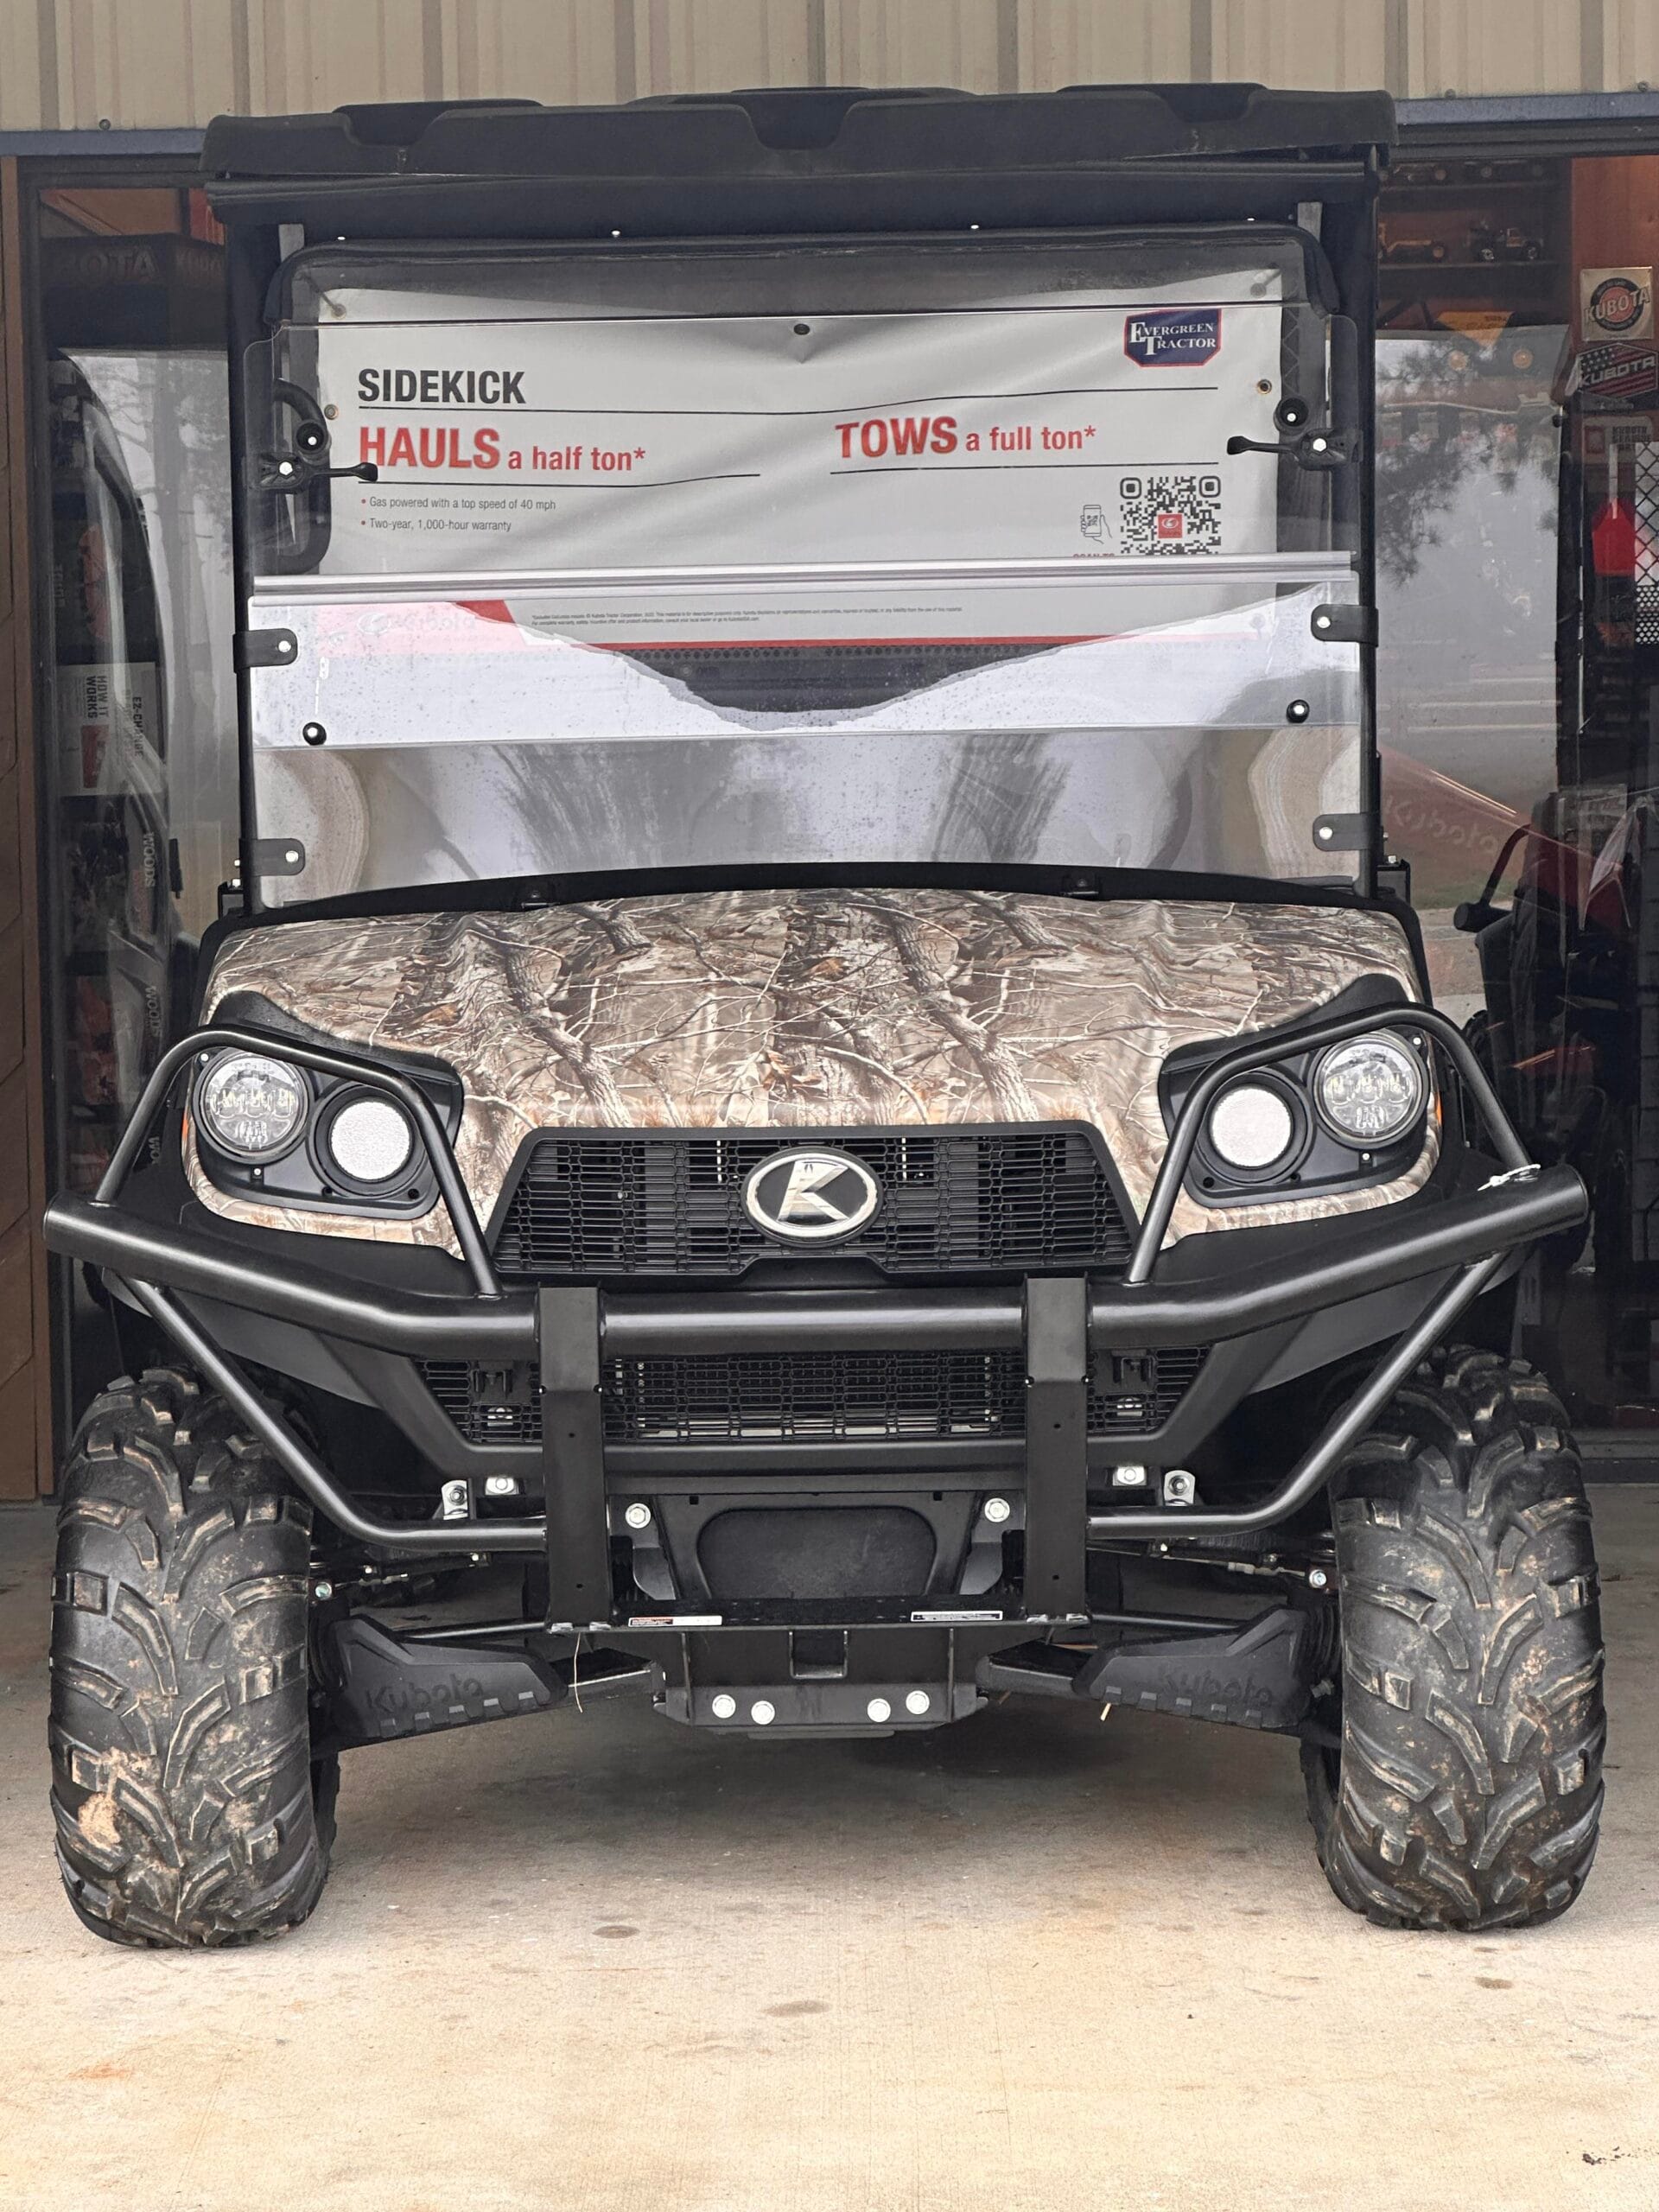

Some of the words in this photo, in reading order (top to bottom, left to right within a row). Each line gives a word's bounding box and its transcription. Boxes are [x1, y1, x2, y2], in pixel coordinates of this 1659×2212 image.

[1584, 286, 1650, 324] KUBOTA
[1129, 321, 1215, 343] EVERGREEN
[1141, 335, 1217, 356] TRACTOR
[358, 368, 526, 404] SIDEKICK
[1580, 355, 1656, 385] KUBOTA
[359, 426, 501, 469] HAULS
[507, 450, 522, 470] a
[532, 446, 582, 471] half
[835, 416, 958, 459] TOWS
[966, 432, 980, 452] a
[989, 426, 1032, 451] full
[369, 496, 387, 508] Gas
[390, 497, 429, 510] powered
[431, 498, 450, 509] with
[453, 499, 459, 509] a
[461, 499, 476, 512] top
[478, 499, 506, 512] speed
[508, 499, 518, 510] of
[520, 499, 533, 510] 40
[536, 499, 556, 512] mph
[369, 518, 415, 531] Two-year,
[418, 518, 469, 531] 1,000-hour
[472, 520, 512, 532] warranty
[86, 675, 98, 719] WORKS
[96, 675, 107, 702] HOW
[143, 831, 156, 887] WOODS
[365, 1672, 485, 1713] Kubota
